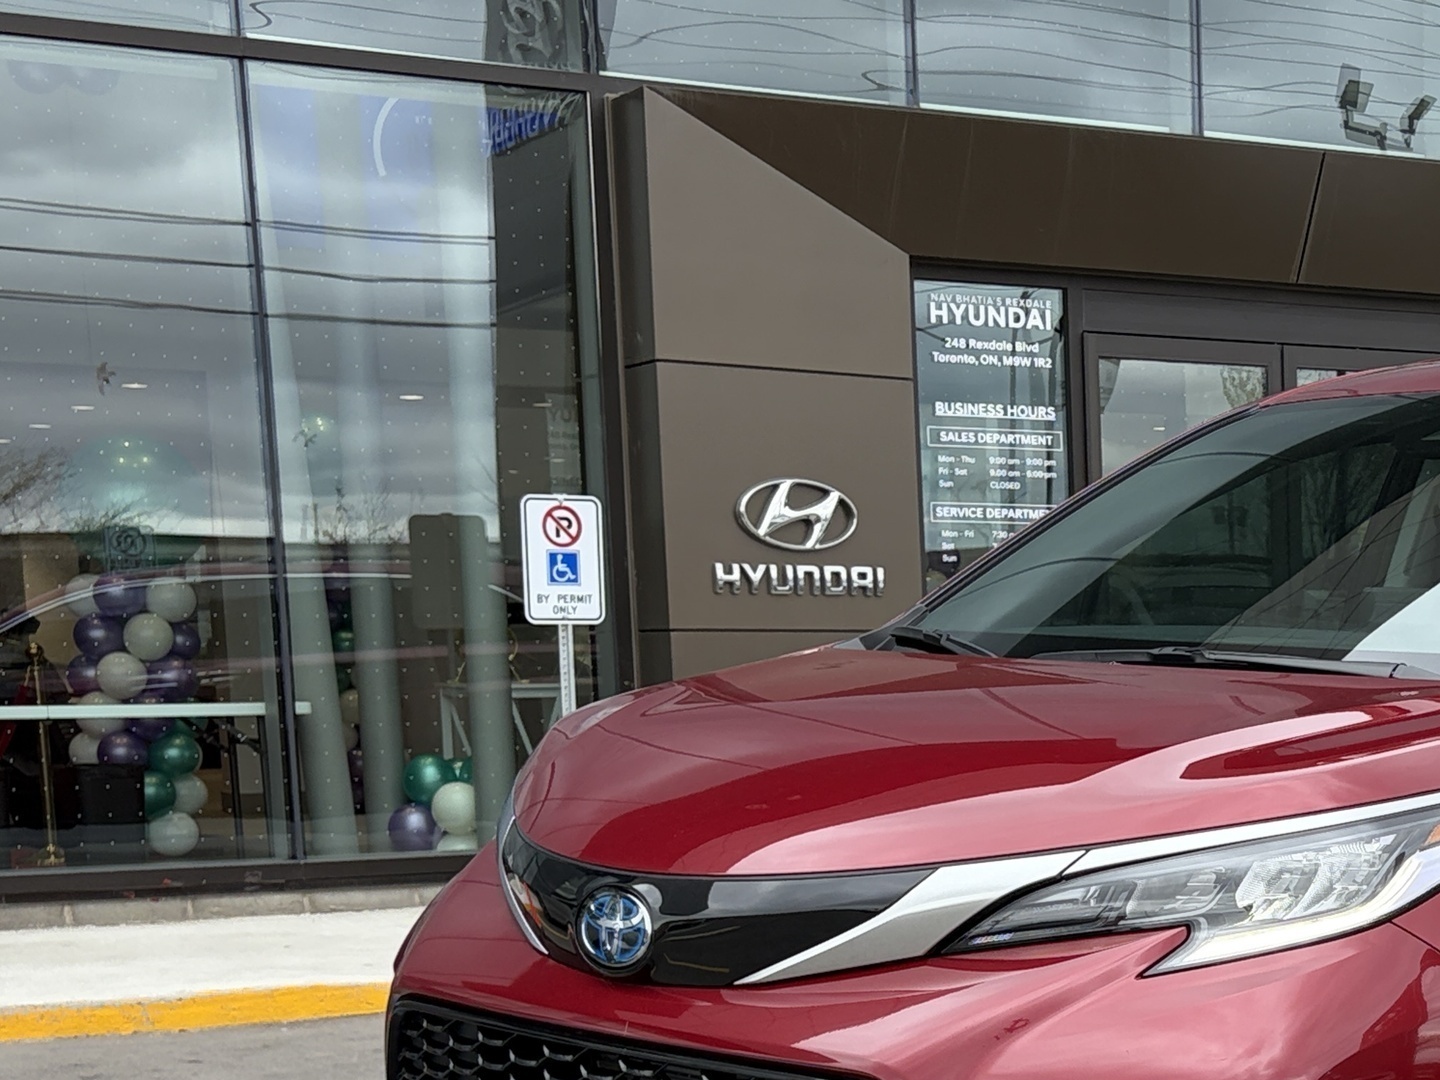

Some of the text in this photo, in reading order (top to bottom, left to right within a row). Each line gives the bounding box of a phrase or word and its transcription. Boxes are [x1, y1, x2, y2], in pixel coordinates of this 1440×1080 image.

[930, 293, 1052, 309] NAV BHATIA'S REXDALE
[929, 301, 1052, 331] HYUNDAI
[944, 337, 1040, 353] 248 Rexdale Blvd
[931, 351, 1052, 369] Toronto, ON, M9W 1R2
[935, 401, 1056, 420] BUSINESS HOURS
[939, 431, 1053, 446] SALES DEPARTMENT
[937, 455, 955, 463] Mon
[938, 467, 949, 475] Fri
[938, 479, 1021, 490] Sun CLOSED
[935, 506, 984, 519] SERVICE
[713, 562, 886, 597] HYUNDAI
[536, 593, 593, 605] BY PERMIT
[552, 604, 578, 616] ONLY
